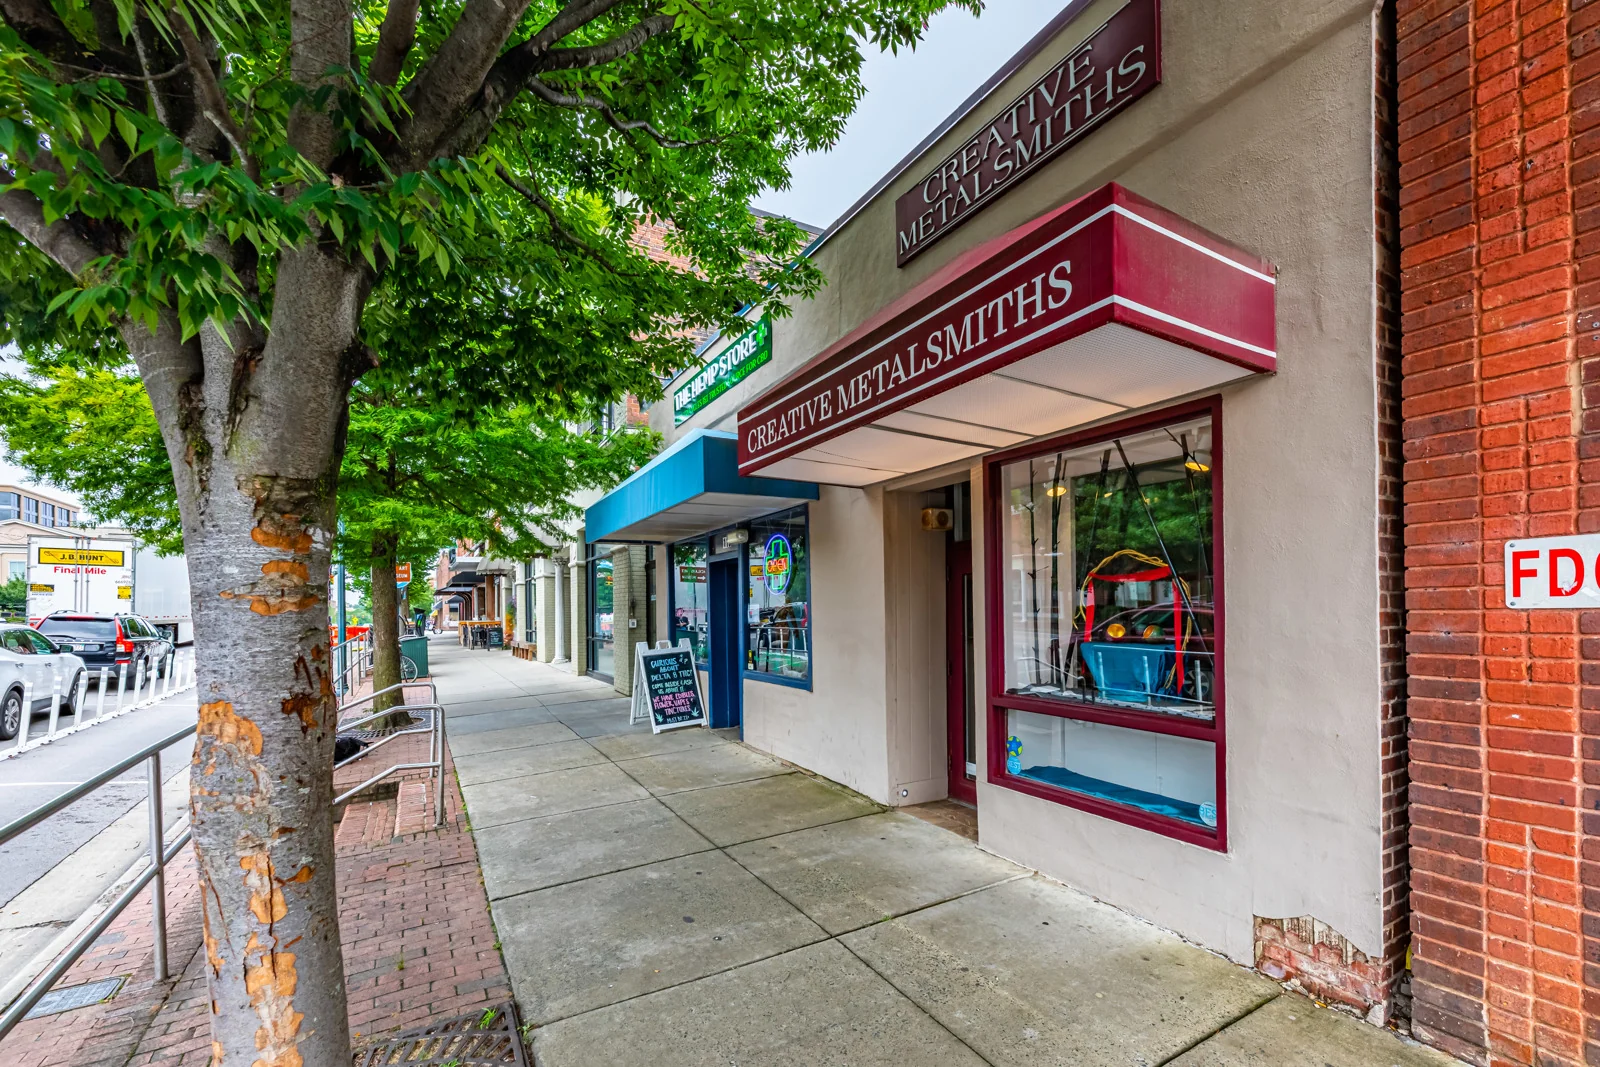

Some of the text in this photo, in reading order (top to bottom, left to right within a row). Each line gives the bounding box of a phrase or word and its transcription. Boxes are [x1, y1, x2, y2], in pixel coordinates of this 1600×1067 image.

[923, 44, 1095, 204] CREATIVE
[899, 44, 1147, 256] METALSMITHS
[745, 359, 757, 374] FOR
[757, 350, 768, 365] CBD
[747, 260, 1073, 453] CREATIVE METALSMITHS
[674, 384, 692, 411] THE
[691, 363, 719, 398] HEMP
[719, 329, 758, 376] STORE
[53, 566, 107, 575] Final Mile
[767, 557, 788, 573] OPEN
[1512, 548, 1600, 598] FD
[651, 658, 677, 669] CURIOUS
[660, 665, 679, 673] ABOUT
[651, 673, 671, 682] DELTA
[673, 671, 678, 679] 8
[652, 695, 660, 704] WE
[661, 693, 674, 701] HAVE
